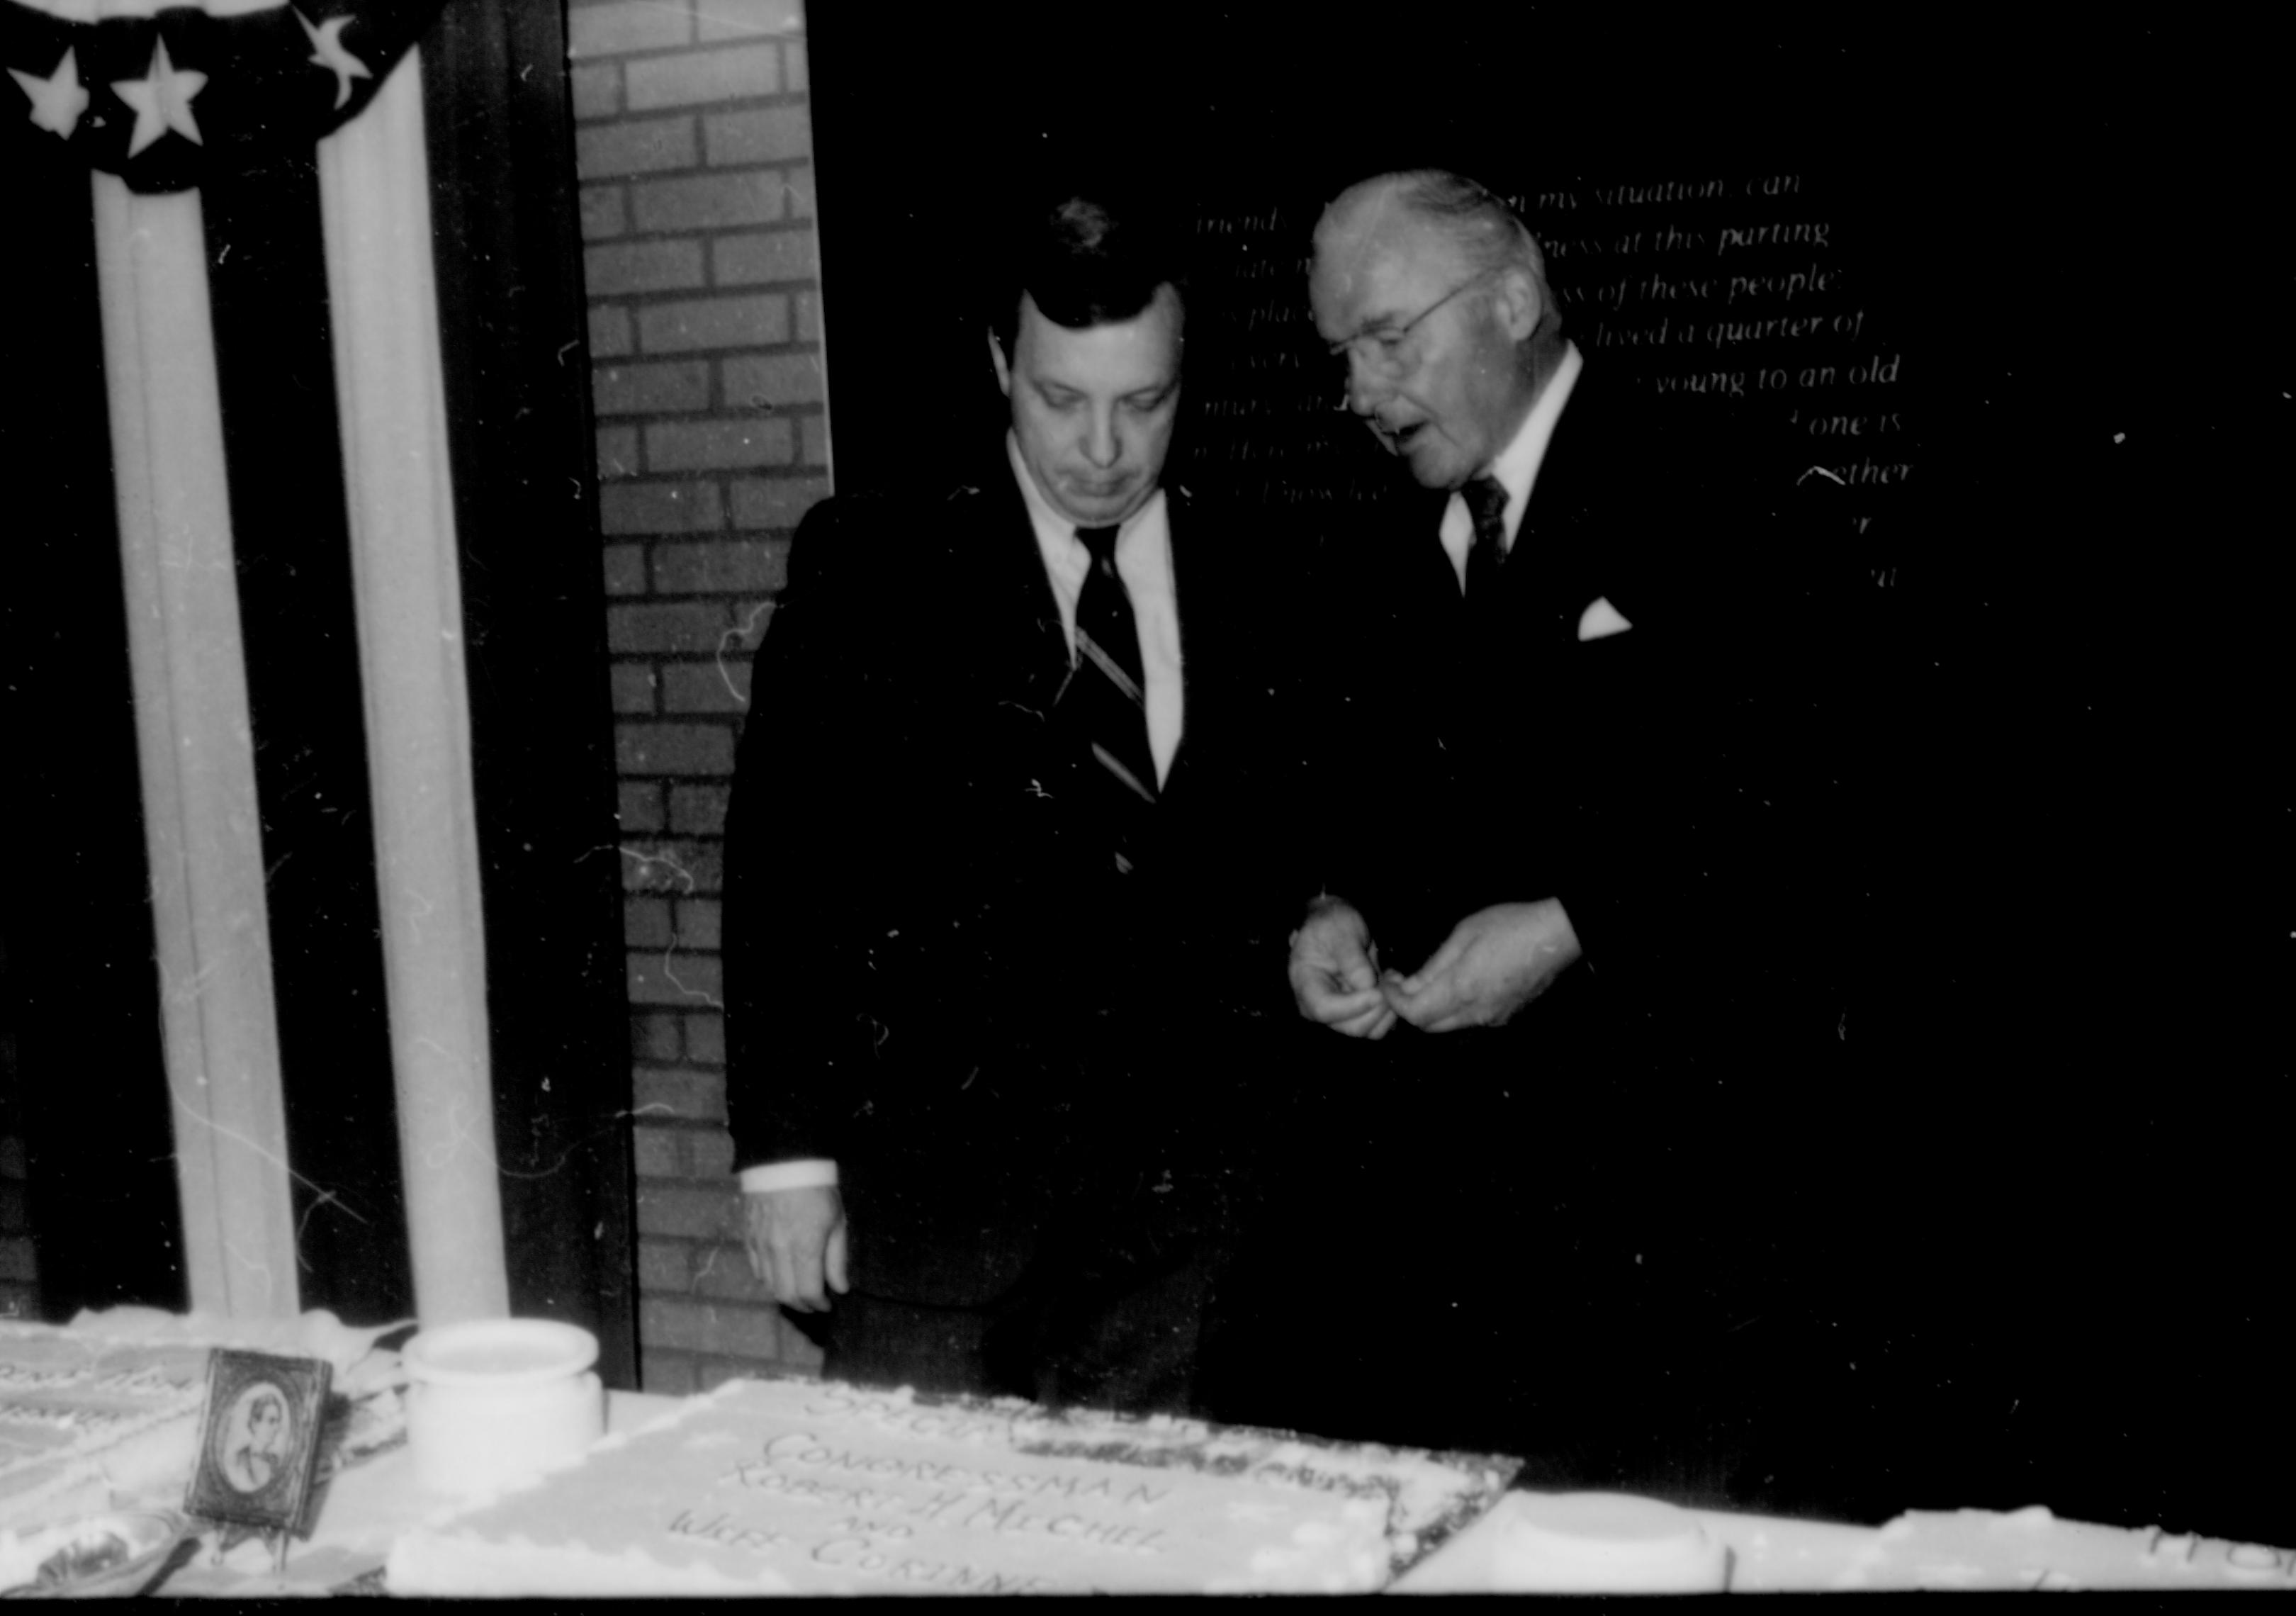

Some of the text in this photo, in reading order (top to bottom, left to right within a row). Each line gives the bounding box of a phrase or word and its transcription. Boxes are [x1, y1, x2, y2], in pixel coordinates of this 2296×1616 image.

[1538, 191, 1579, 212] my
[1745, 174, 1801, 197] can
[1614, 231, 1642, 255] at
[1655, 223, 1706, 252] this
[1718, 223, 1830, 257] parting
[1599, 274, 1632, 312] of
[1640, 273, 1718, 301] these
[1597, 316, 1670, 347] lived
[1679, 323, 1694, 344] a
[1706, 315, 1824, 350] quarter
[1833, 307, 1865, 344] of
[1656, 370, 1745, 399] young
[1757, 367, 1788, 391] to
[1798, 365, 1836, 389] an
[1848, 352, 1901, 385] old
[1808, 415, 1869, 437] one
[1879, 412, 1901, 434] is
[764, 1432, 1174, 1504] CONGRESSMAN
[908, 1491, 969, 1521] H
